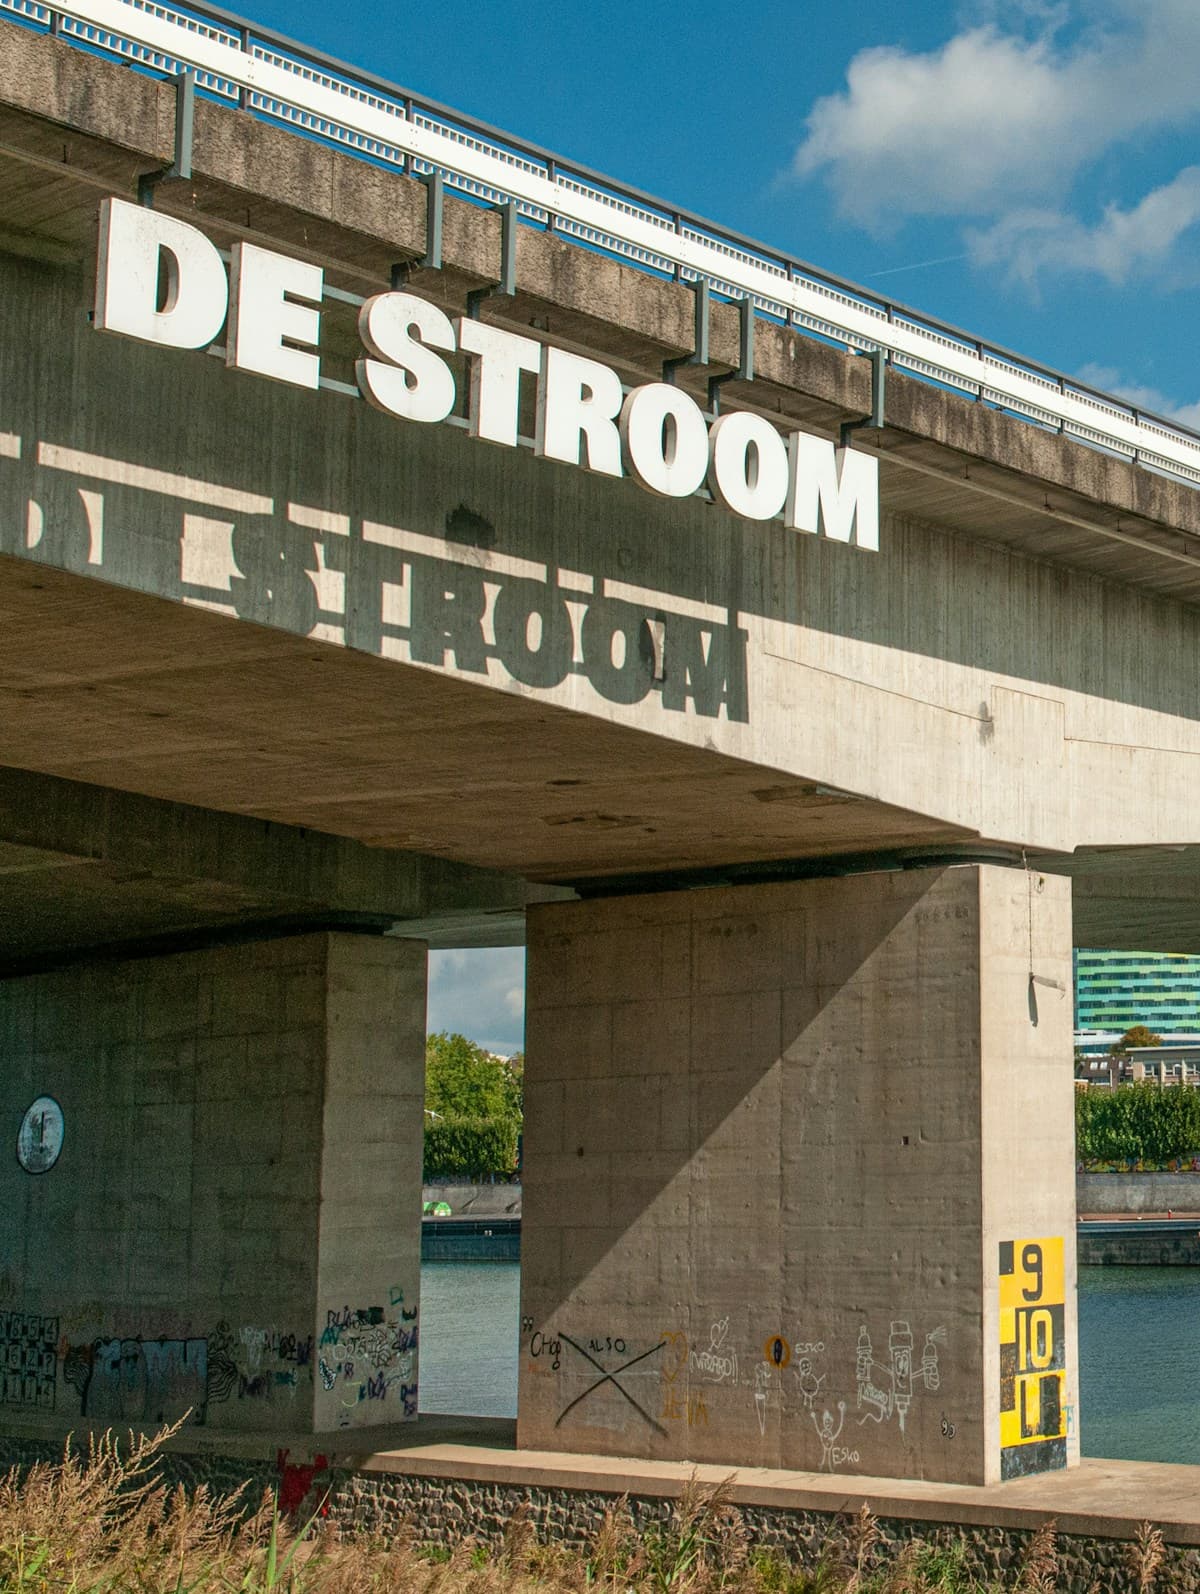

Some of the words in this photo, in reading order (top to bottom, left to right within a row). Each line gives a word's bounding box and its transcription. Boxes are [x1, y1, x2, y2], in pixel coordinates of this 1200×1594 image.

[95, 197, 324, 390] DE
[356, 290, 880, 552] STROOM
[1022, 1243, 1043, 1301] 9
[1019, 1309, 1053, 1370] 10
